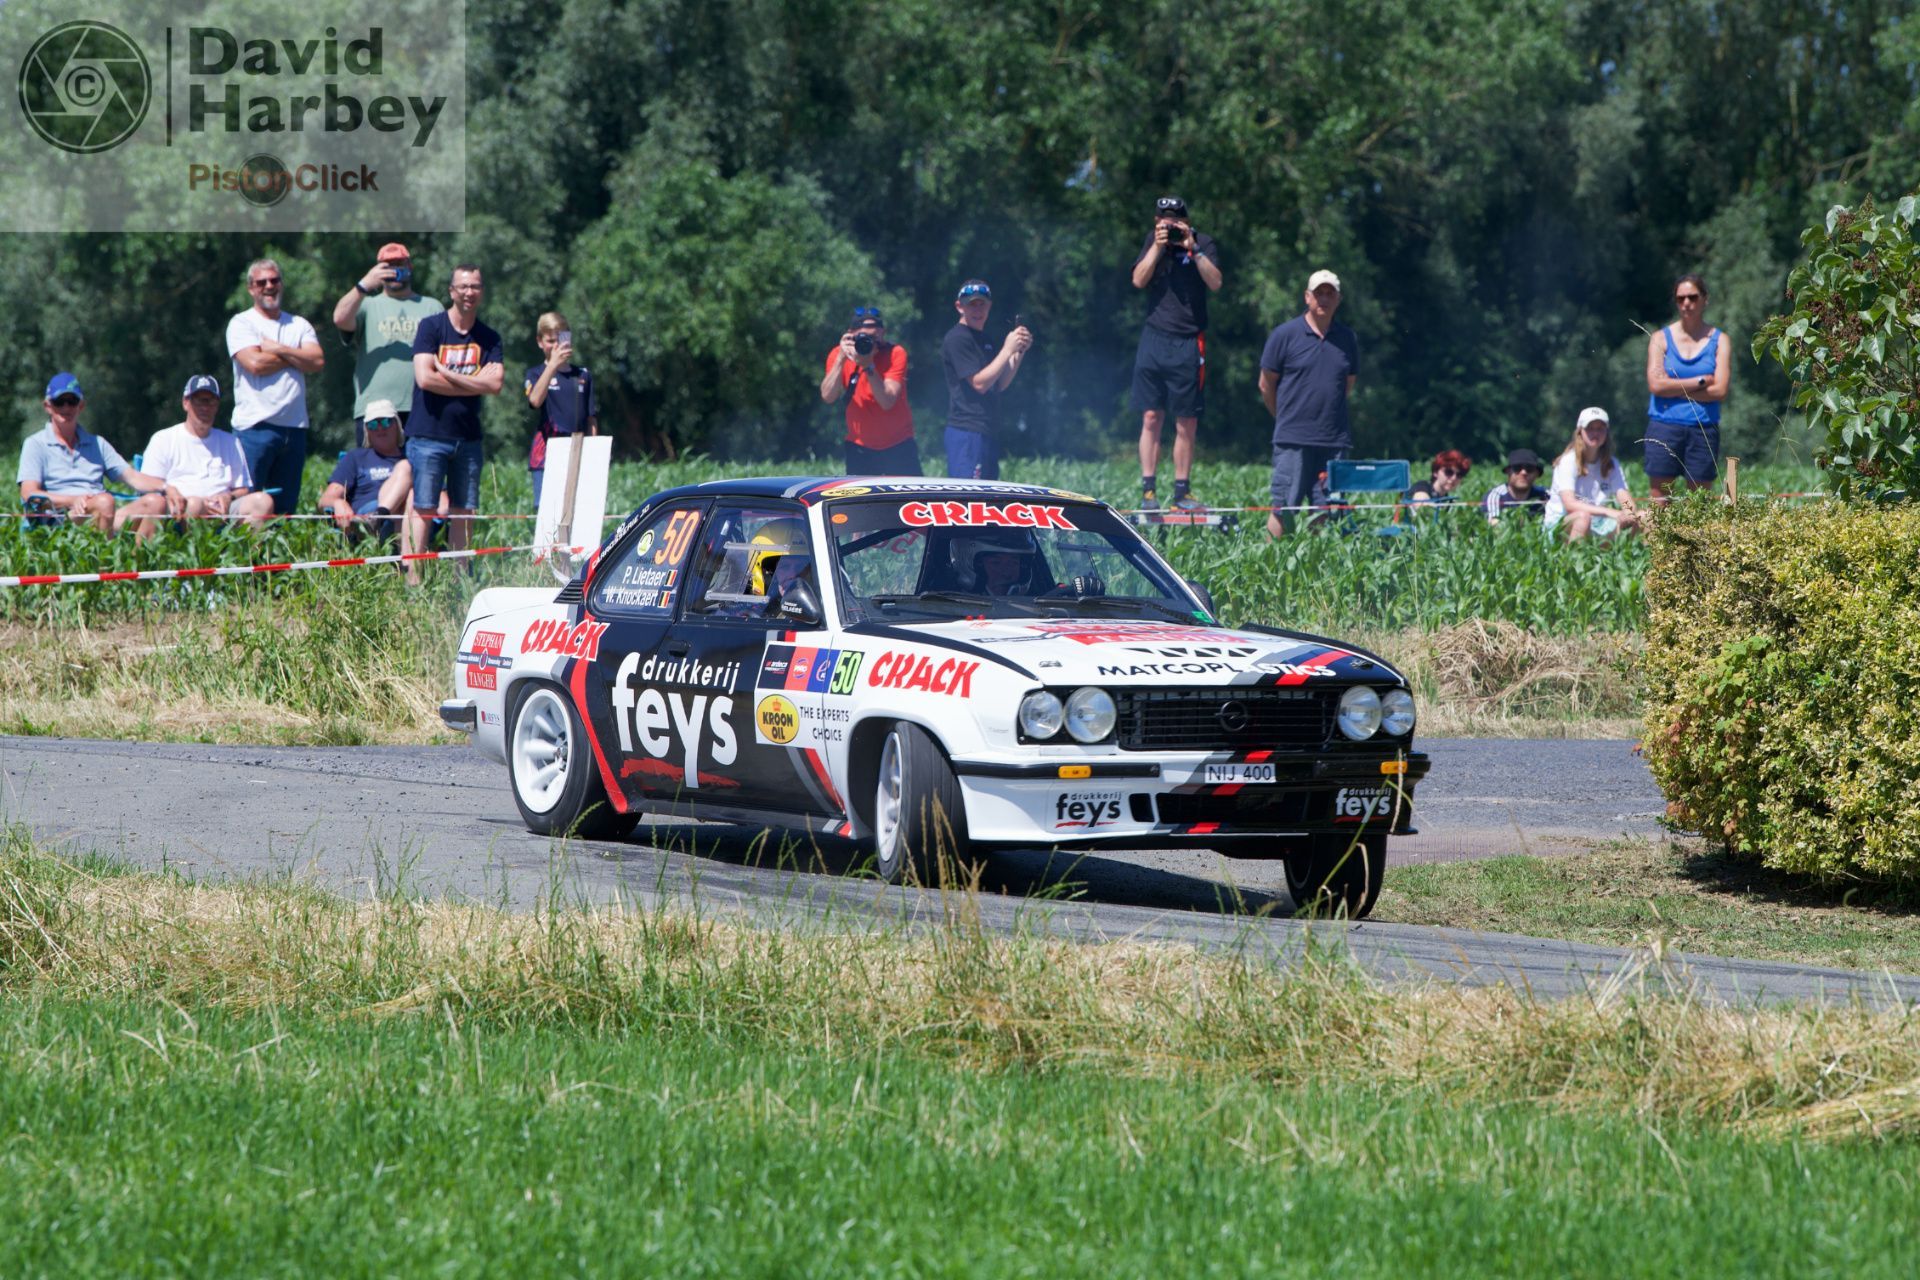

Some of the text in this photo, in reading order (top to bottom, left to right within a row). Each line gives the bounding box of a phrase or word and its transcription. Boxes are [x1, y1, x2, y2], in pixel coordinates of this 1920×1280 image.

[899, 501, 1080, 531] CRACK
[654, 510, 701, 566] 50
[621, 566, 667, 586] P. Lietaer
[605, 585, 659, 607] W. Knockaert
[520, 618, 610, 662] CRACK
[642, 654, 740, 695] drukkerij
[831, 651, 862, 694] 50
[868, 650, 981, 698] CRACK
[612, 652, 738, 788] feys
[762, 711, 793, 727] KROON
[800, 706, 814, 719] THE
[771, 726, 786, 740] OIL
[812, 727, 842, 741] CHOICE
[1208, 765, 1272, 781] NIJ 400
[1070, 792, 1122, 801] drukkerij
[1349, 787, 1392, 797] drukkerij
[1056, 793, 1121, 828] feys
[1335, 788, 1391, 824] feys
